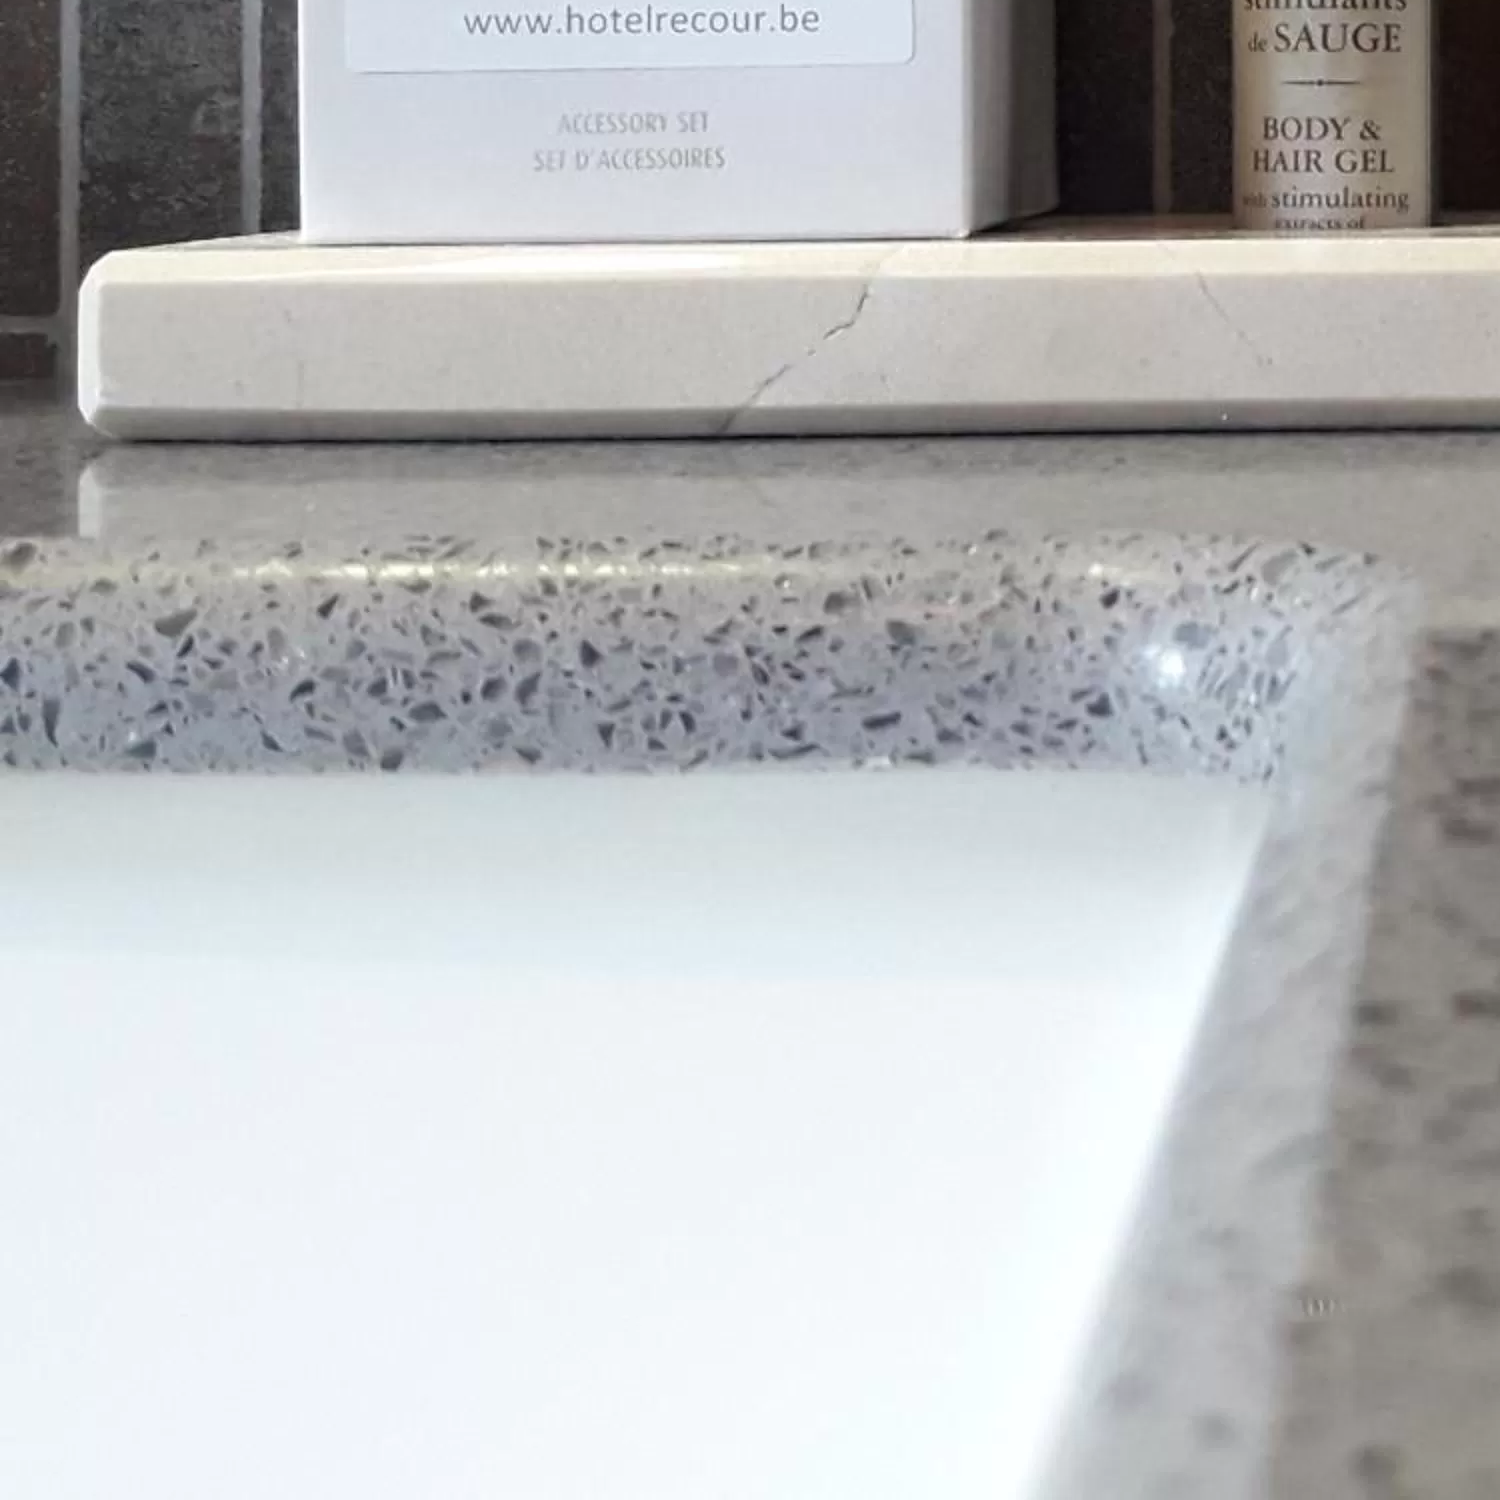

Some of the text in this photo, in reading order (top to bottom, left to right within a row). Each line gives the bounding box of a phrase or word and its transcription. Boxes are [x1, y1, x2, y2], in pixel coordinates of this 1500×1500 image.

[464, 3, 820, 35] www.hotelrecour.be
[1248, 22, 1402, 53] de SAUGE
[557, 110, 709, 134] ACCESSORY SET
[1263, 116, 1381, 141] BODY &
[533, 150, 565, 172] SET
[1252, 149, 1395, 174] HAIR GEL
[1271, 186, 1409, 213] stimulating
